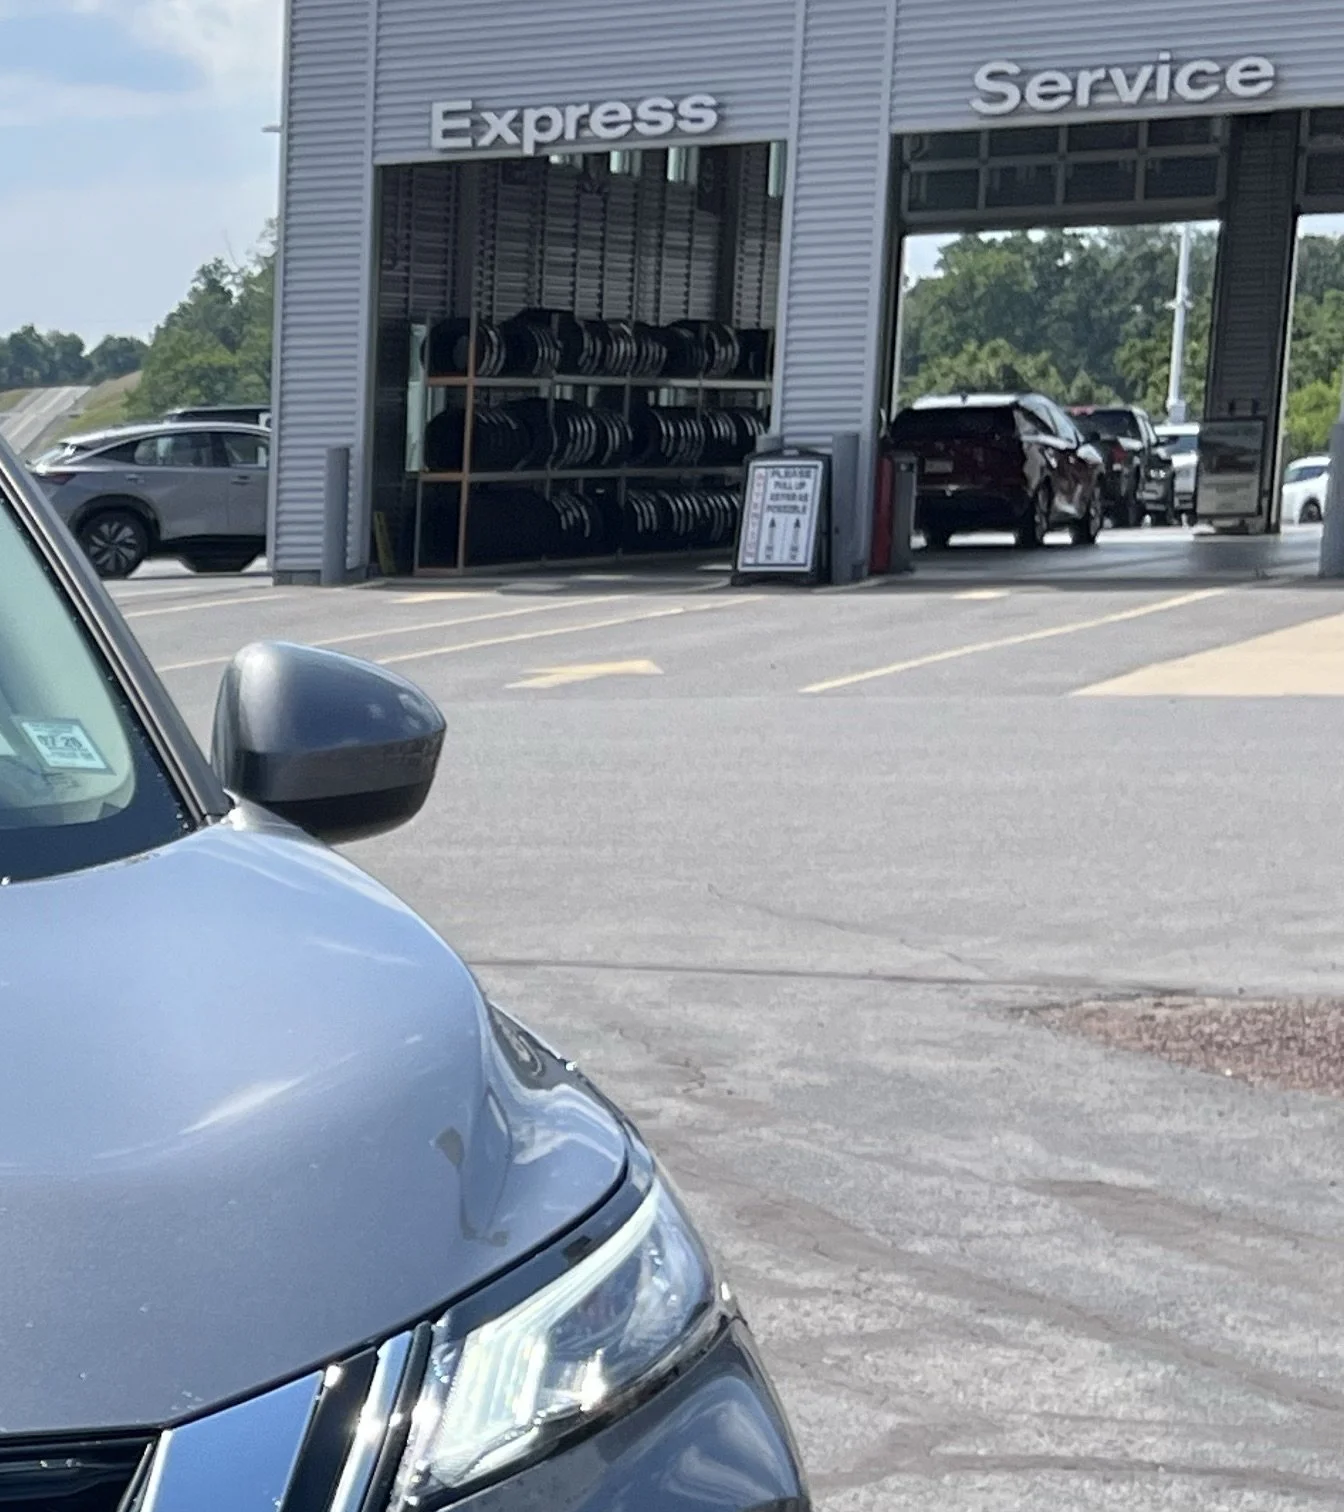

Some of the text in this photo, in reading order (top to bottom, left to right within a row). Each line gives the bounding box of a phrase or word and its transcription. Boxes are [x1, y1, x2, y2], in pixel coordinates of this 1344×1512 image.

[969, 50, 1276, 116] Service
[430, 93, 719, 156] Express
[771, 470, 811, 478] PLEASE
